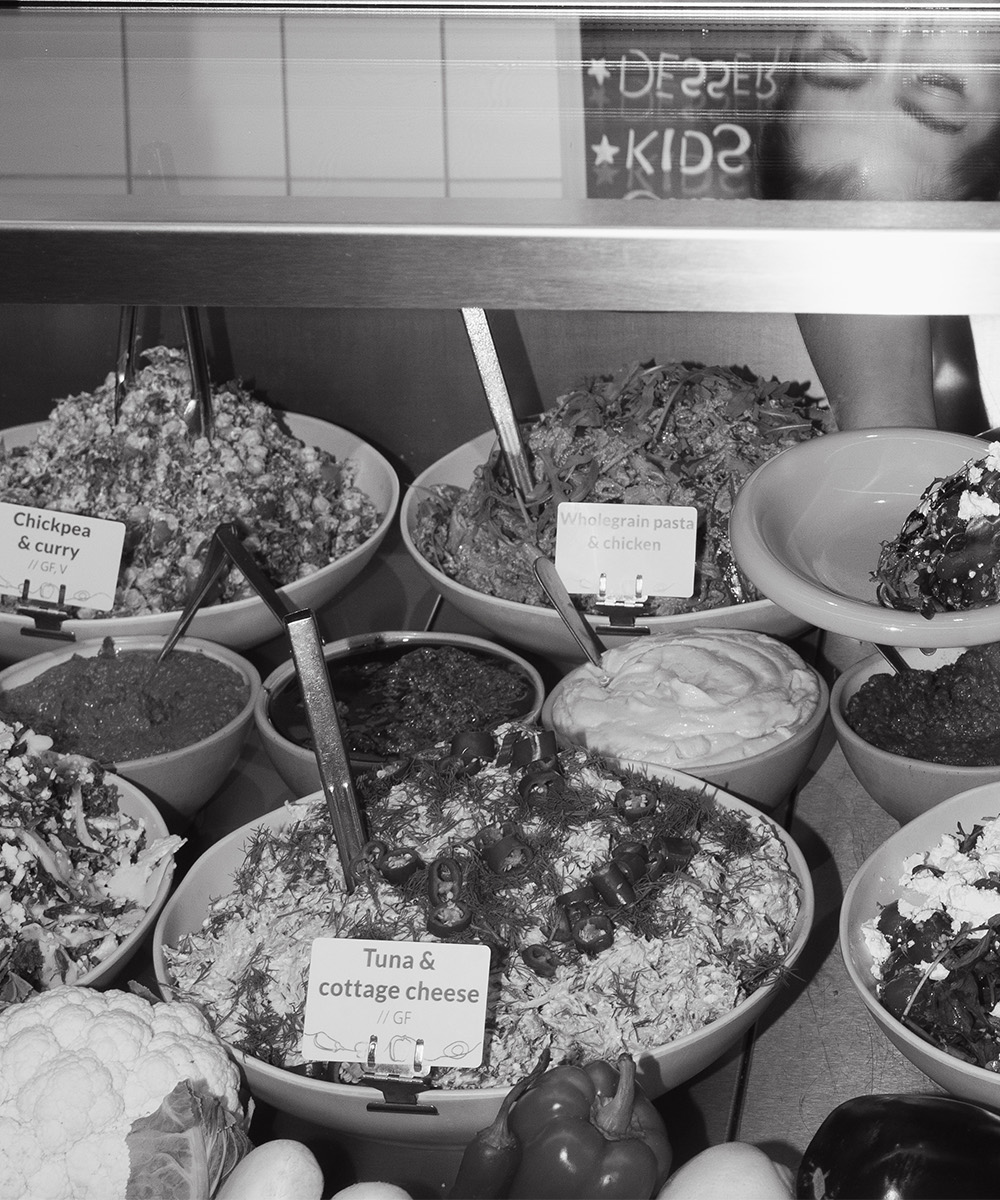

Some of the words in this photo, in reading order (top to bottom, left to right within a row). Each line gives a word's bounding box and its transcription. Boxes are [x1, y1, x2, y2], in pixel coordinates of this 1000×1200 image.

[13, 511, 91, 538] Chickpea
[560, 512, 650, 530] Wholegrain
[653, 518, 694, 531] pasta
[18, 535, 31, 551] &
[35, 541, 80, 560] curry
[588, 535, 599, 549] &
[603, 536, 661, 551] chicken
[60, 563, 68, 575] V
[363, 948, 414, 969] Tuna
[419, 951, 436, 971] &
[319, 979, 400, 1003] cottage
[405, 981, 480, 1003] cheese
[393, 1011, 412, 1025] GF
